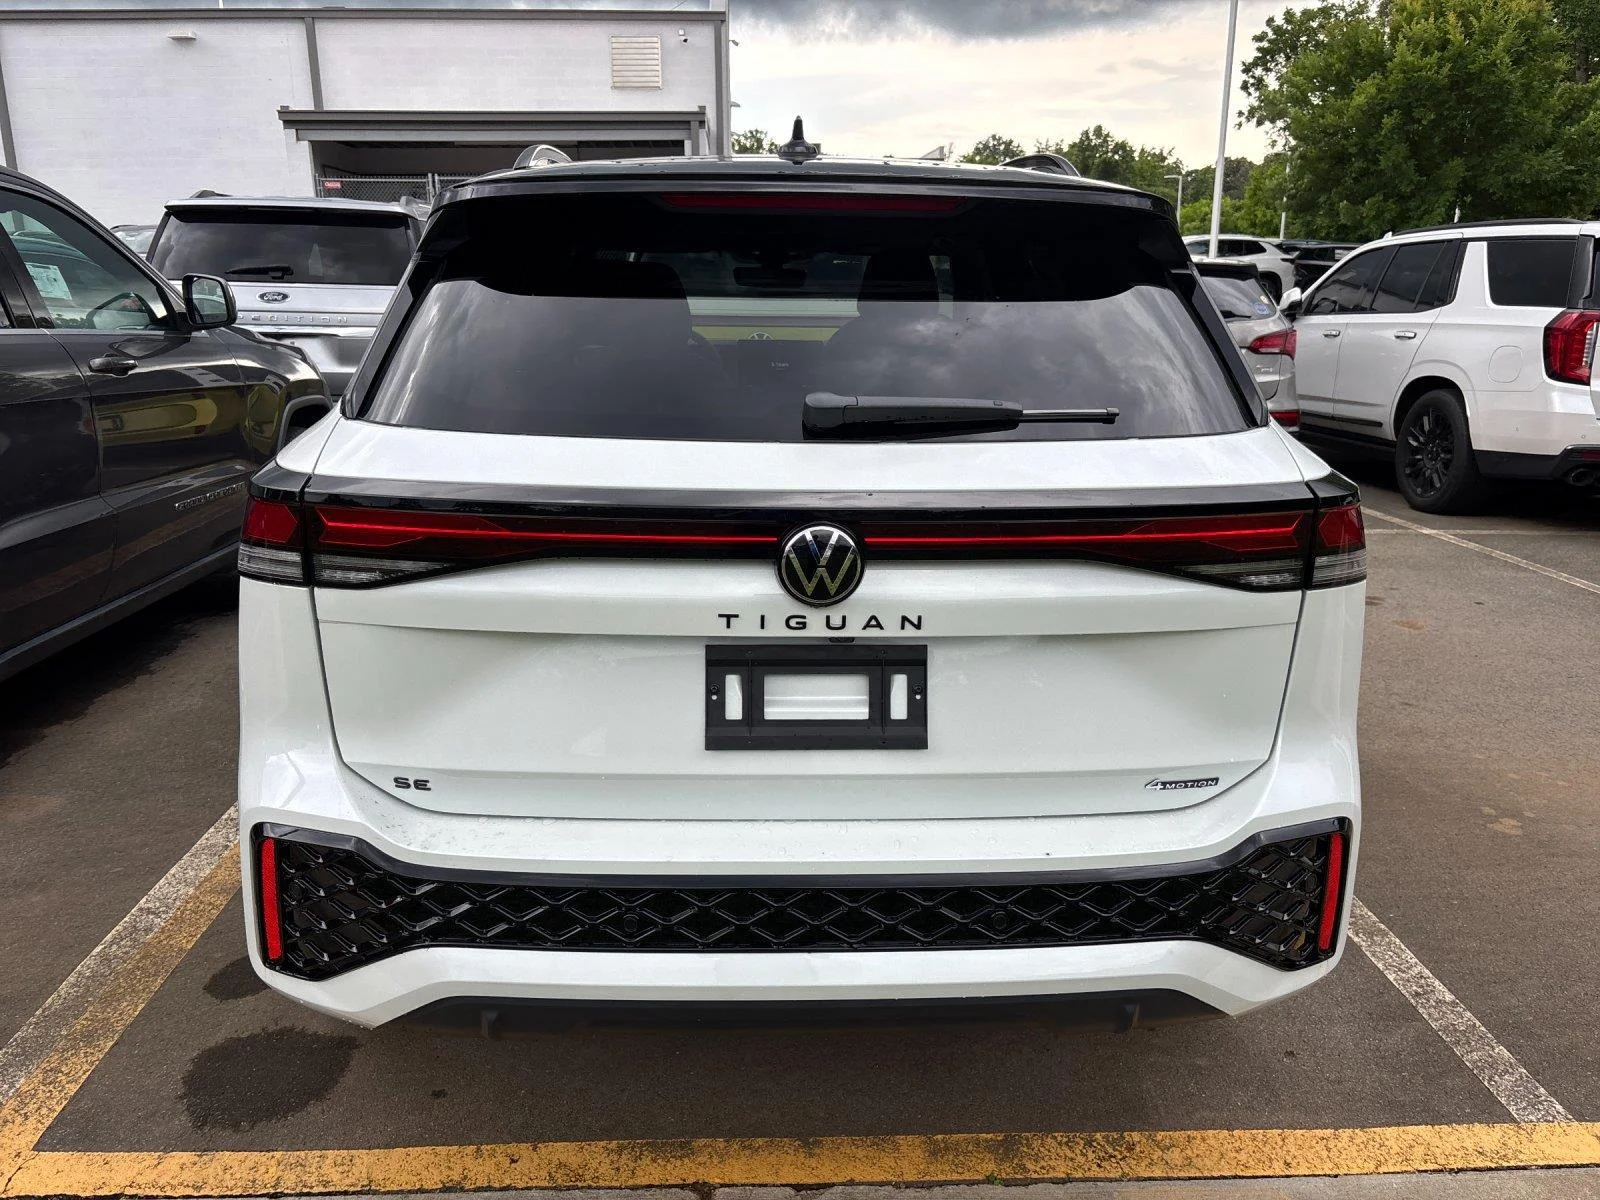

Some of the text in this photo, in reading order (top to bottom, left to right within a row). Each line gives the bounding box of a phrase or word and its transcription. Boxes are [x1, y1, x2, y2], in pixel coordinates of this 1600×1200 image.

[717, 613, 923, 631] TIGUAN
[392, 776, 432, 791] SE
[1144, 777, 1218, 791] 4MOTION
